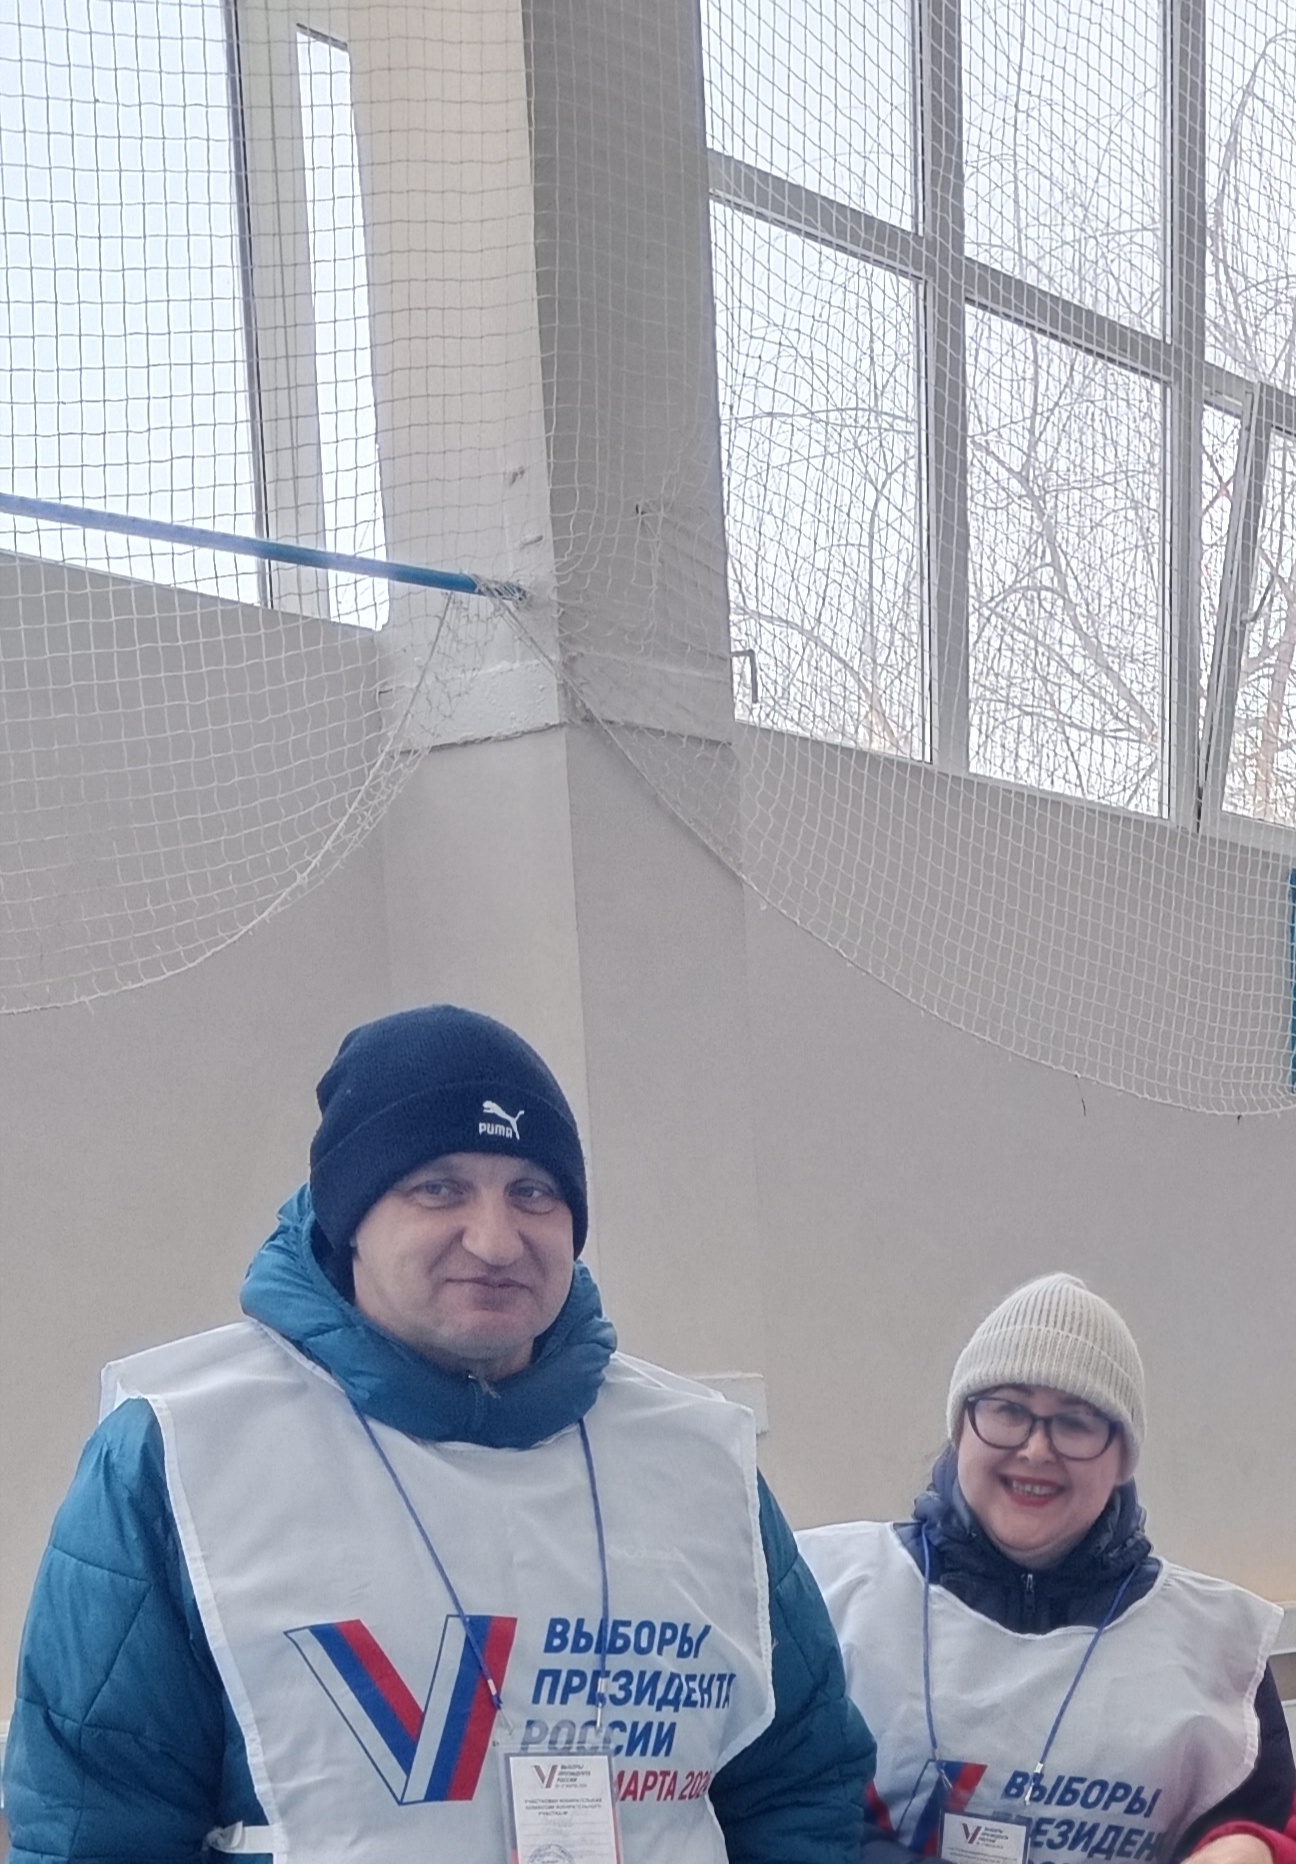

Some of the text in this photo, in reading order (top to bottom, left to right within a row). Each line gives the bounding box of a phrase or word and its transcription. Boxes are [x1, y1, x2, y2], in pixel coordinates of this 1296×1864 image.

[479, 1122, 513, 1139] PUMA
[543, 1617, 712, 1659] ВЫБОРЫ
[531, 1668, 737, 1713] ПРЕЗИДЕНТА
[520, 1719, 677, 1757] РОССИИ
[1004, 1770, 1163, 1818] ВЫБОРЫ
[993, 1811, 1164, 1862] ЕЗИДЕН
